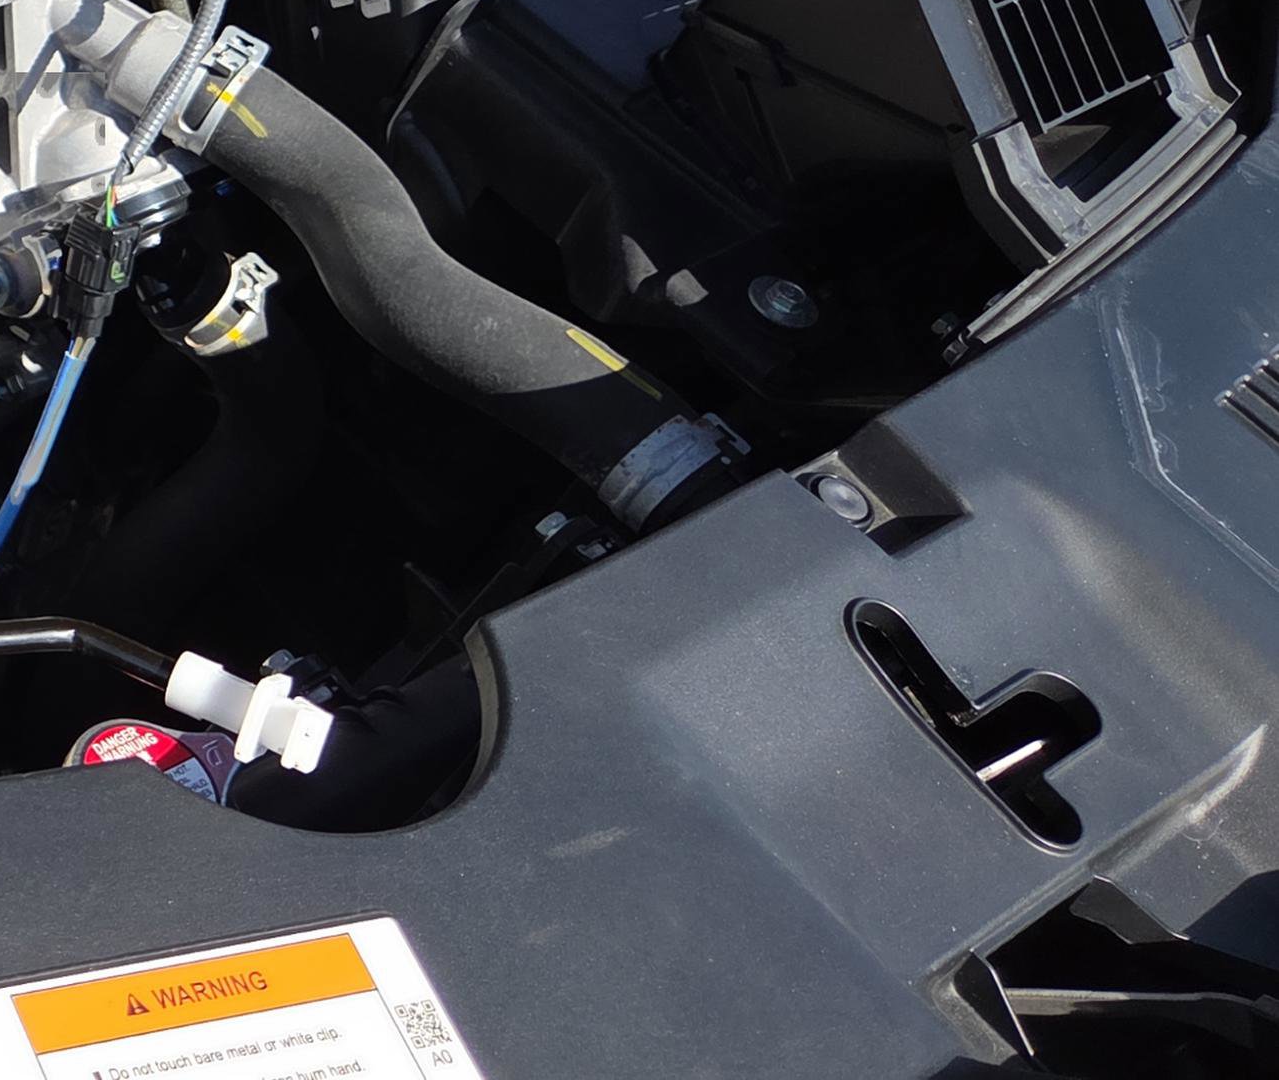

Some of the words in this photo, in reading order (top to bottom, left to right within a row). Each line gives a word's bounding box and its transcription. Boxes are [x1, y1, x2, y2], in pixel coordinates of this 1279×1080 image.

[91, 726, 140, 755] DANGER
[98, 732, 159, 761] WARNUNG
[151, 970, 268, 1010] WARNING
[109, 1067, 130, 1080] Do
[133, 1064, 155, 1077] not
[155, 1052, 193, 1072] touch
[193, 1050, 224, 1066] bare
[226, 1041, 262, 1059] metal
[264, 1039, 278, 1052] or
[280, 1032, 314, 1049] white
[316, 1027, 343, 1043] clip.
[327, 1058, 366, 1076] hand.
